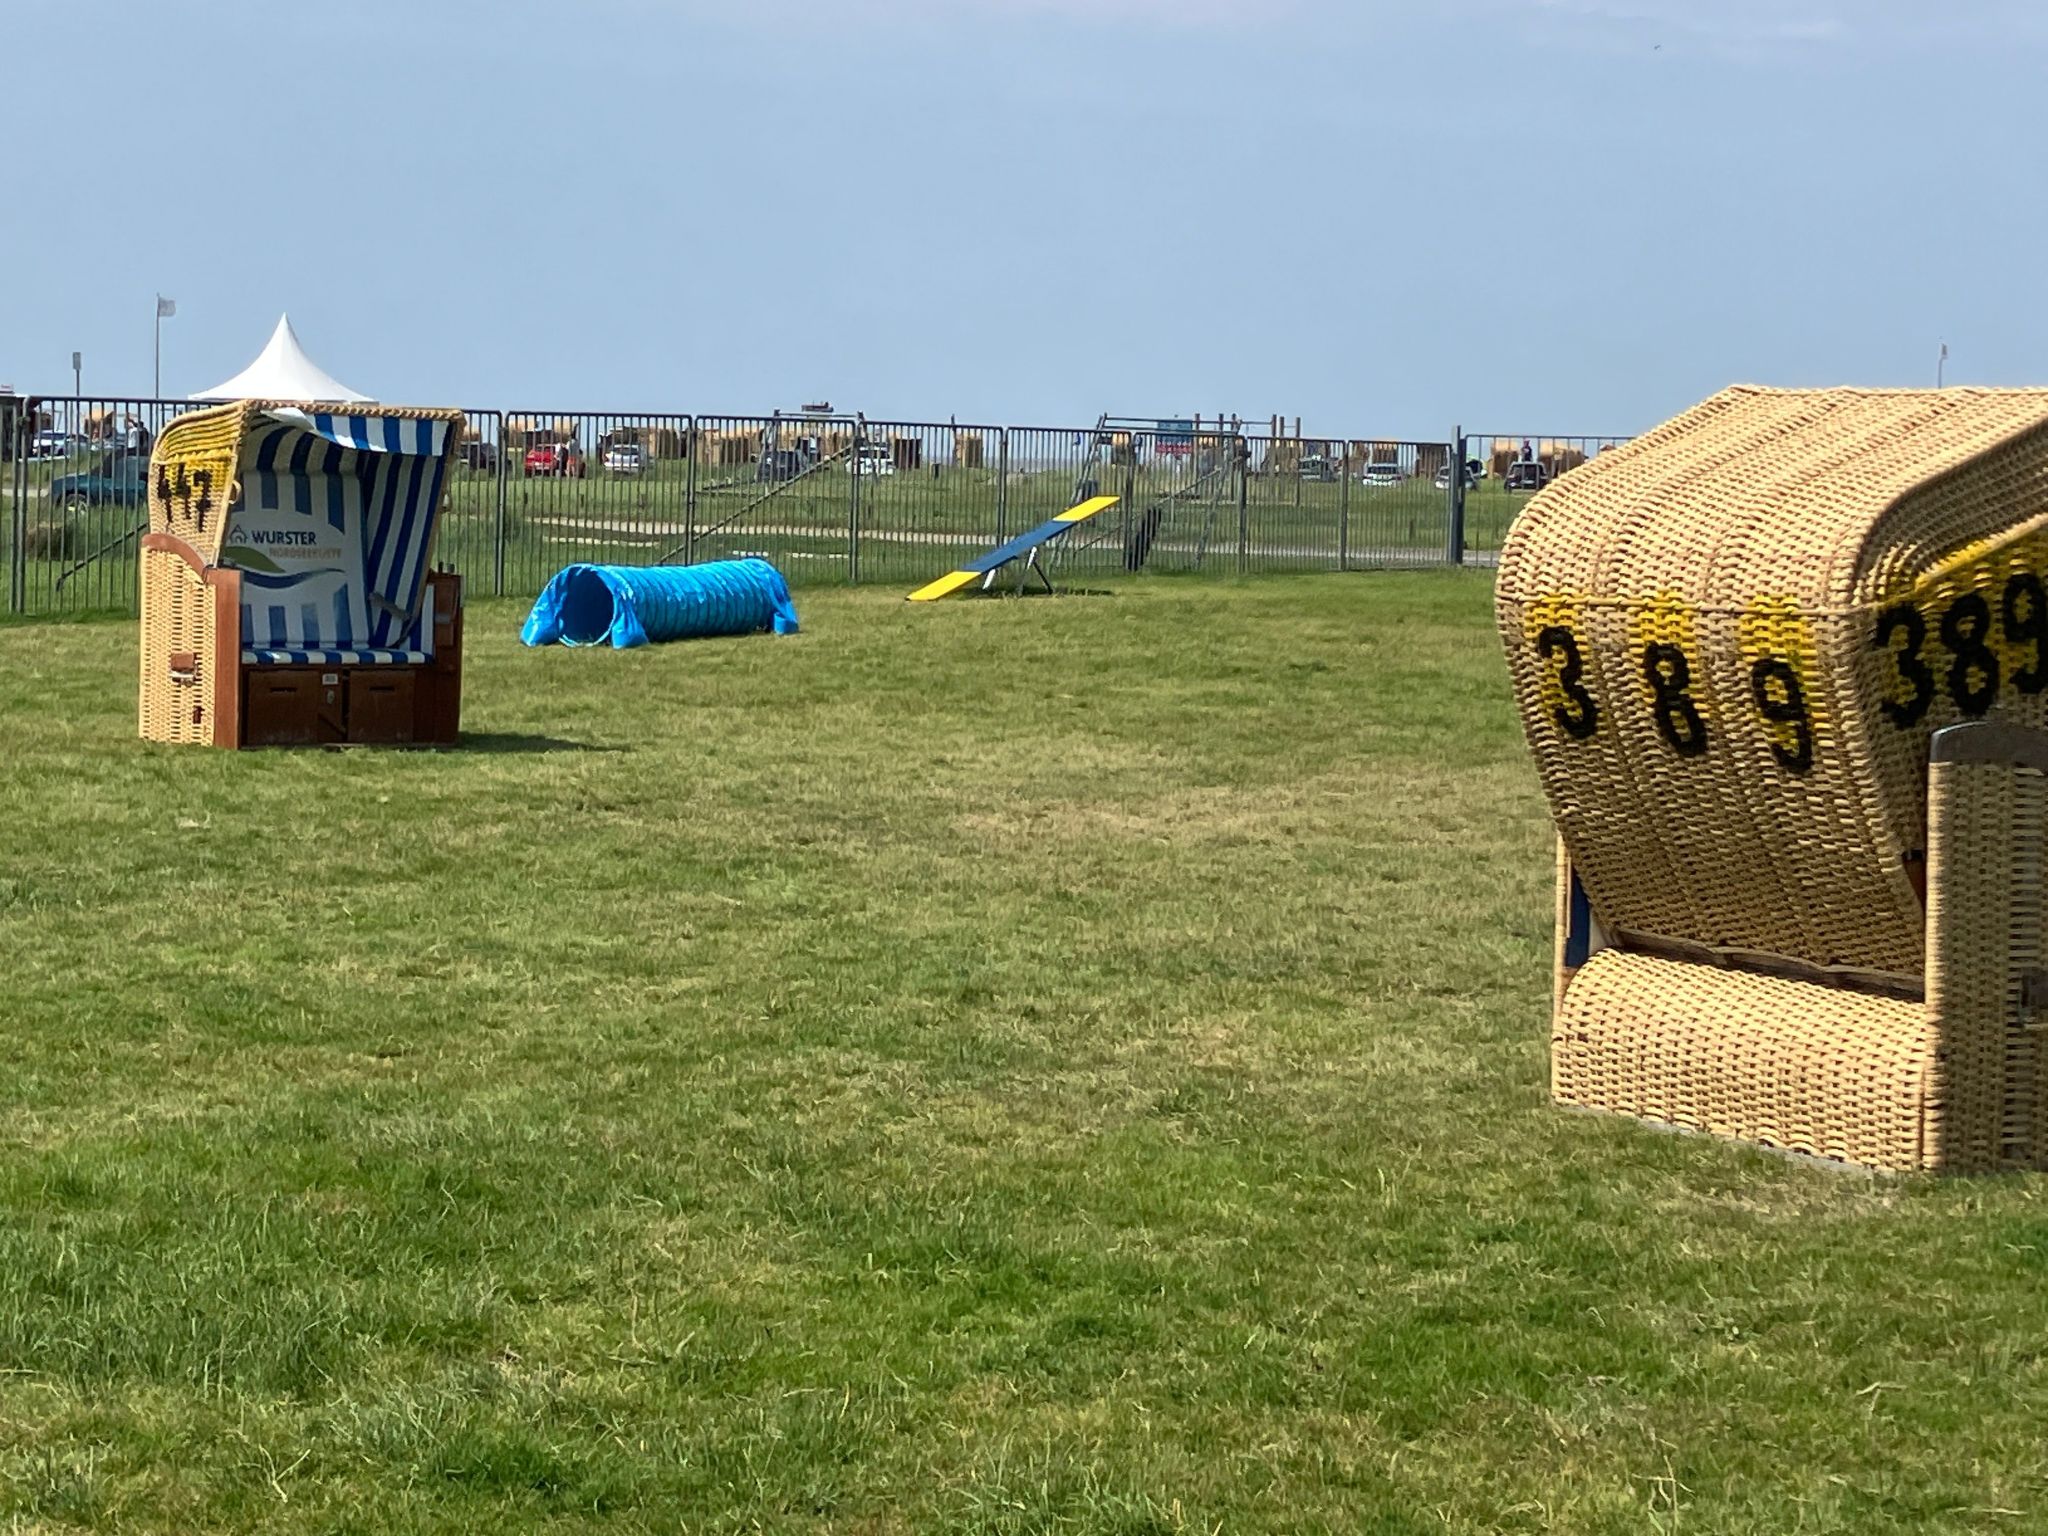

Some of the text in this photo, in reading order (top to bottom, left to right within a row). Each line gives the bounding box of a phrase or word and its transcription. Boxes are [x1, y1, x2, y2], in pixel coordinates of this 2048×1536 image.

[251, 530, 317, 545] WURSTER
[1537, 625, 1813, 771] 389
[1877, 573, 2047, 728] 389
